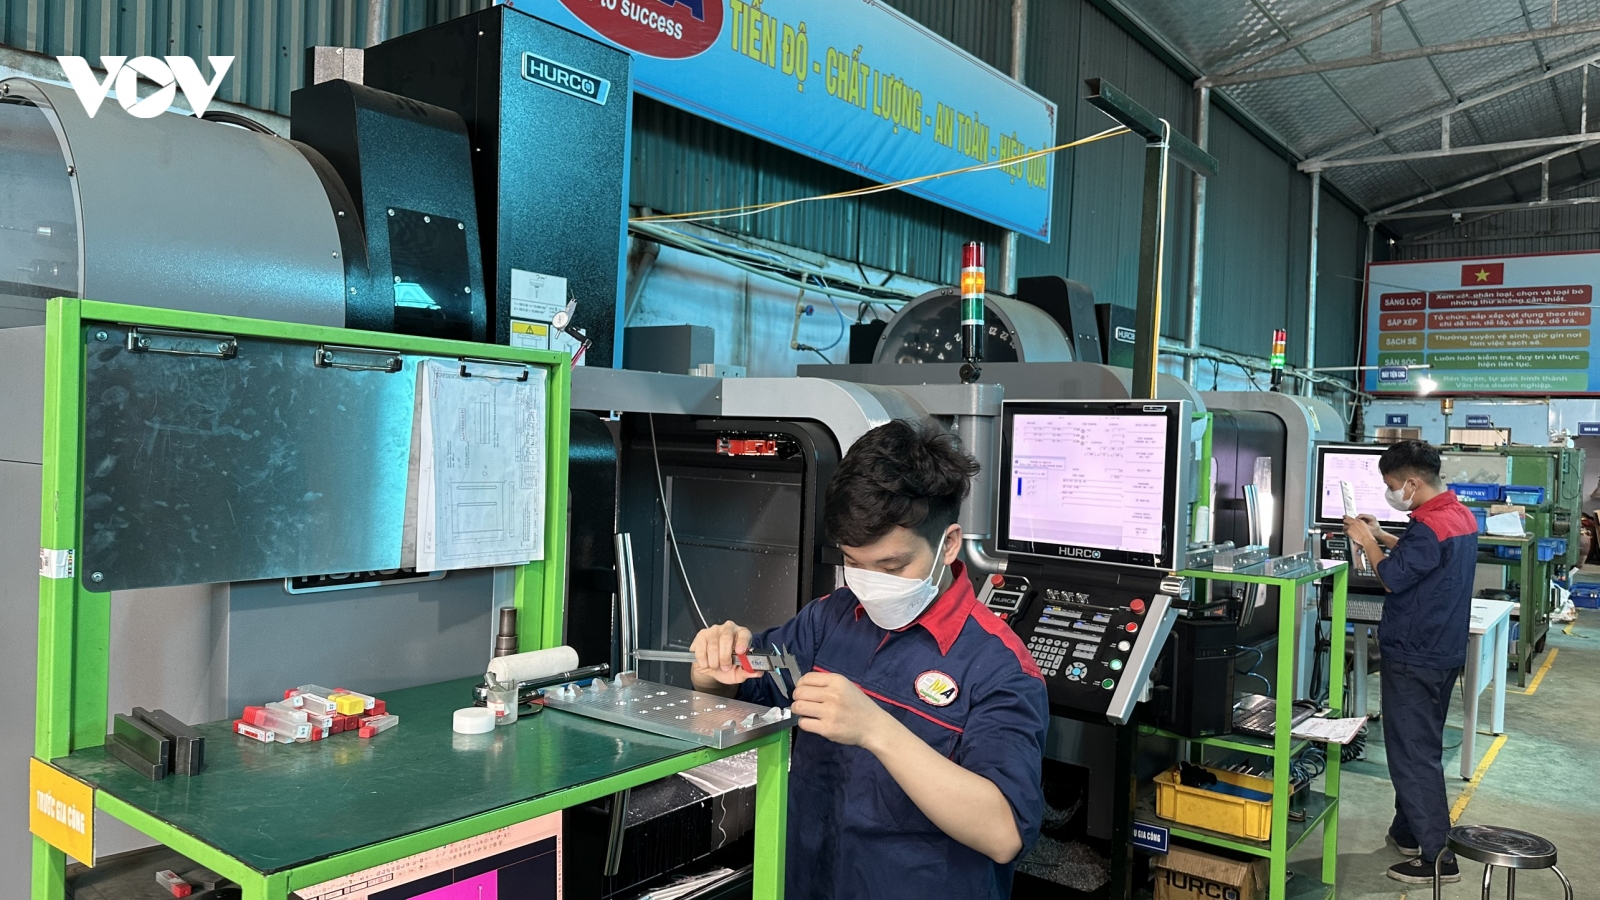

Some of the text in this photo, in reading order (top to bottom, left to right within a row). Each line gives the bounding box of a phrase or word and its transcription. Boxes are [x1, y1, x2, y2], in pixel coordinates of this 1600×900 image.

[620, 0, 682, 40] success
[530, 60, 594, 95] HURCO
[781, 21, 808, 93] ĐỘ
[825, 44, 870, 110] CHẤT
[872, 69, 922, 135] LƯỢNG
[934, 102, 954, 149] AN
[957, 110, 990, 164] TOÀN
[998, 131, 1025, 186] HIỆU
[1384, 298, 1422, 307] SÀNG LỌC
[1386, 338, 1406, 346] SẠCH
[1059, 546, 1101, 559] HURCO
[992, 596, 1016, 604] HURCO
[36, 790, 85, 835] TRƯỚC GIA CÔNG
[1138, 830, 1146, 839] GIA
[1147, 831, 1161, 842] CÔNG
